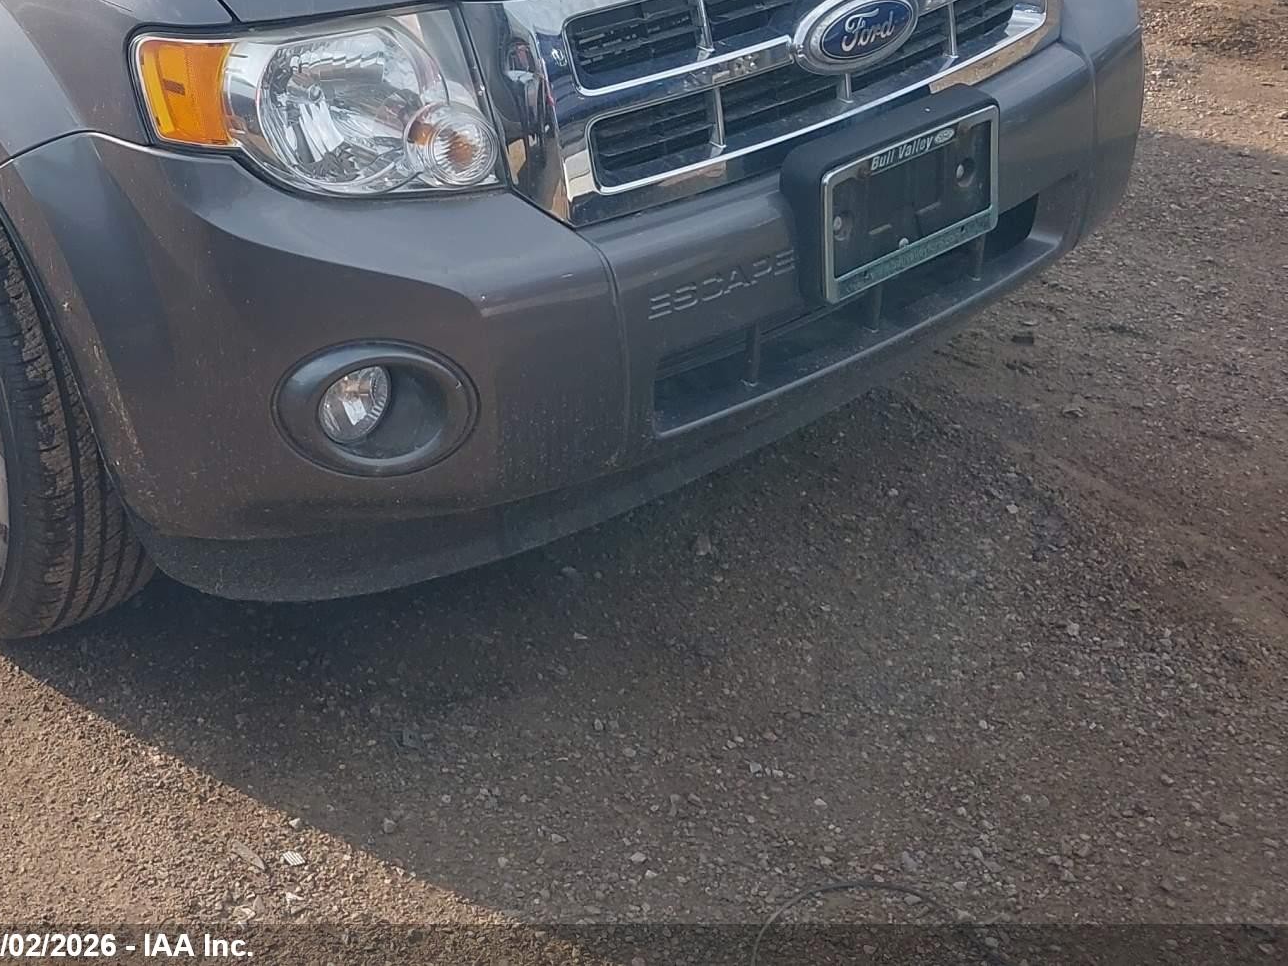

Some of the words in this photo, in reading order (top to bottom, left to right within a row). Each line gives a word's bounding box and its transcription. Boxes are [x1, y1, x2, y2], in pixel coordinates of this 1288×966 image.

[841, 7, 896, 52] Ford
[870, 150, 895, 171] Bull
[898, 135, 934, 161] Valley
[647, 248, 796, 321] ESCAPE
